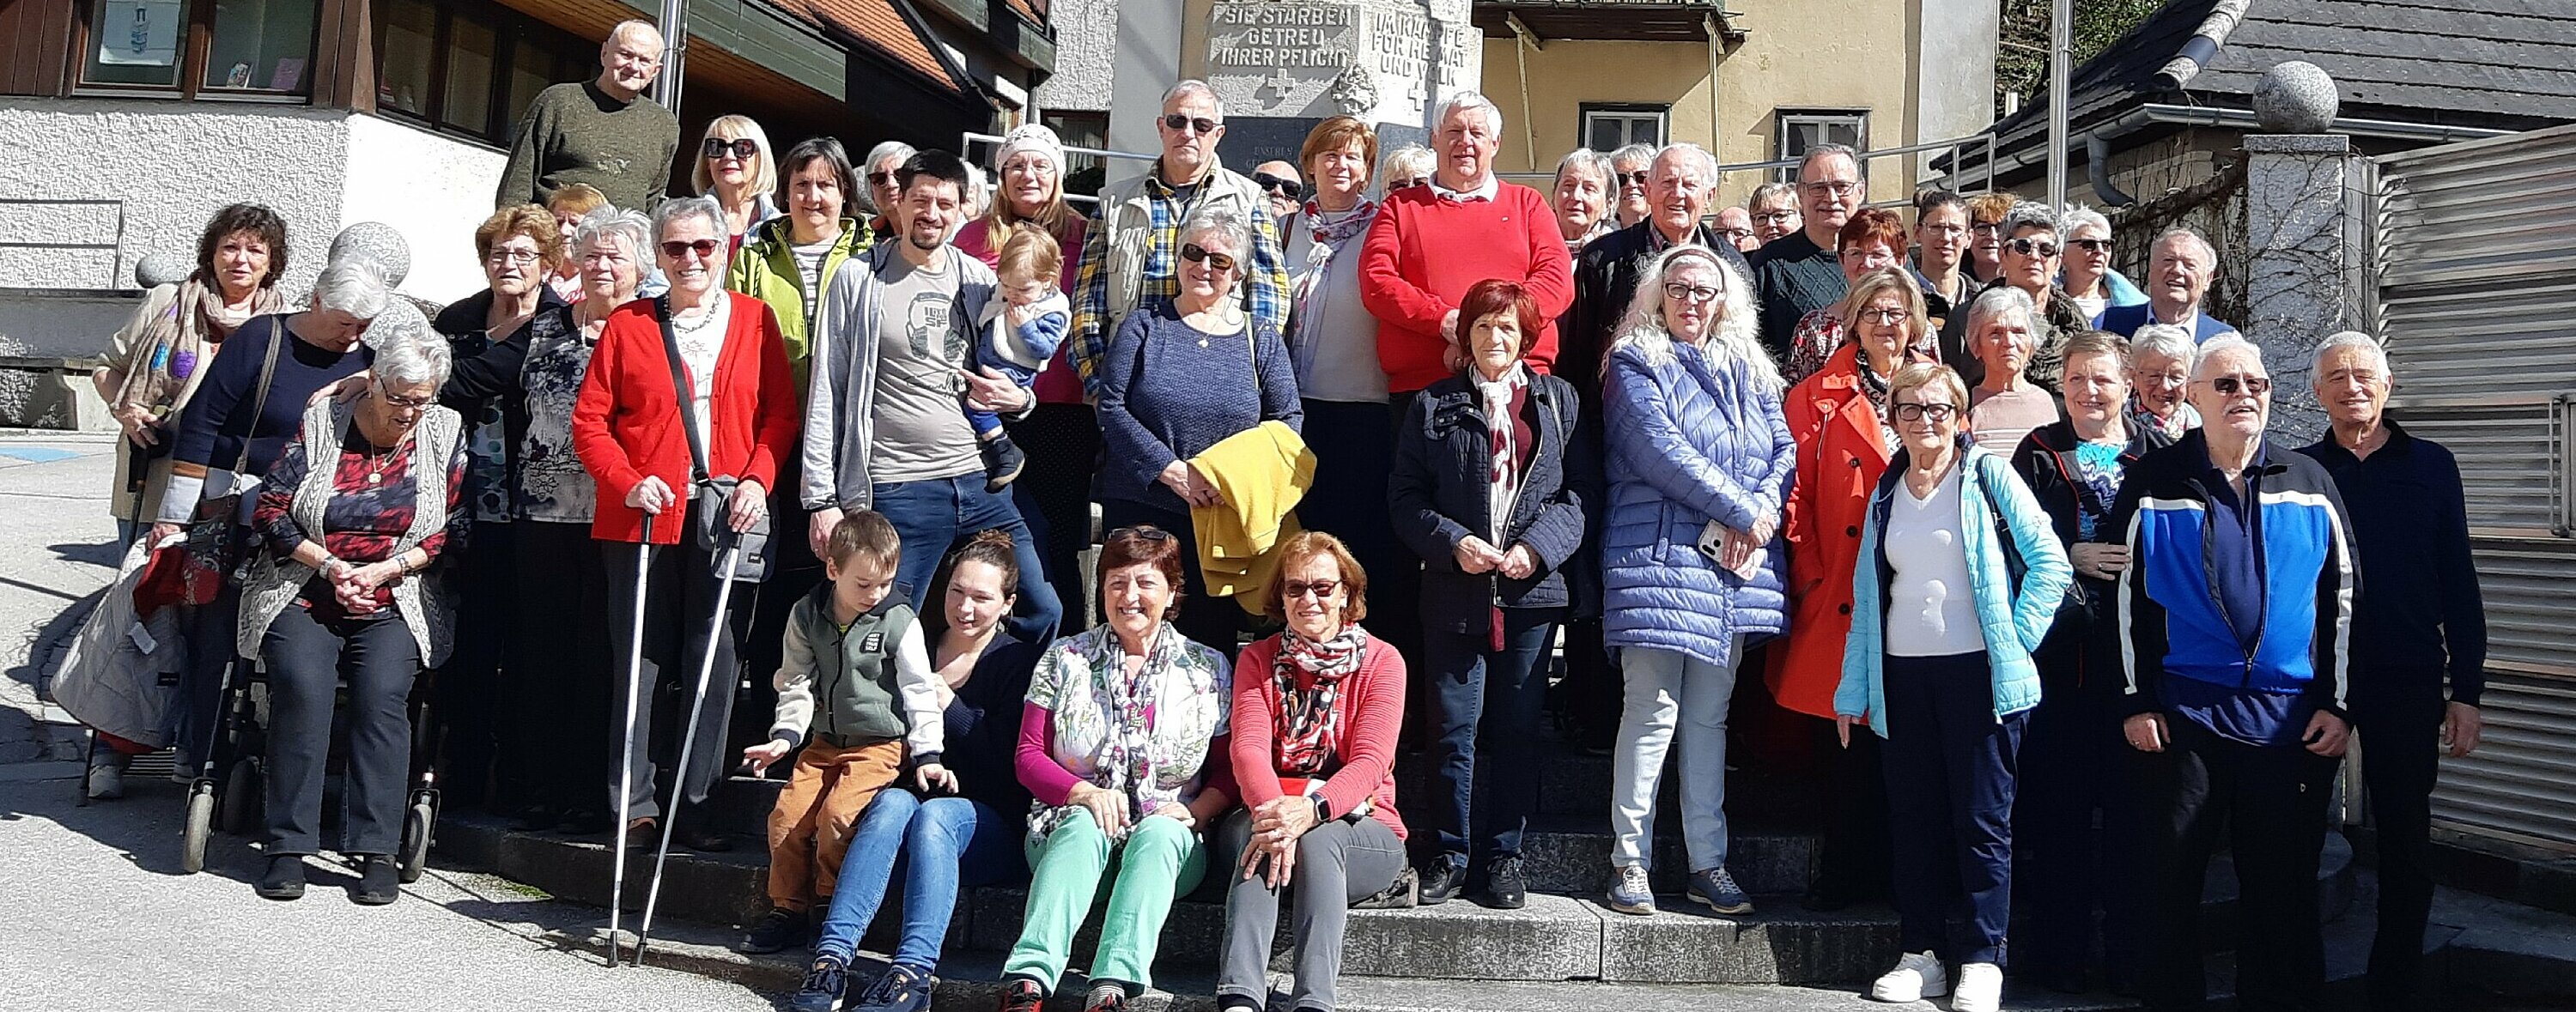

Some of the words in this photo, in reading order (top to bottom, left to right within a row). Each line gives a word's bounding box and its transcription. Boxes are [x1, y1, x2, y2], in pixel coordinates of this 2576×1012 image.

[1224, 7, 1257, 25] SIE
[1262, 7, 1352, 26] STARBEN
[1248, 27, 1325, 46] GETREU
[1400, 15, 1465, 48] KAMFE
[1221, 47, 1275, 66] IHRER
[1279, 48, 1350, 68] PFLICHT
[1408, 39, 1465, 68] HEMAT
[1379, 52, 1412, 77] UND
[1417, 61, 1456, 87] VLK
